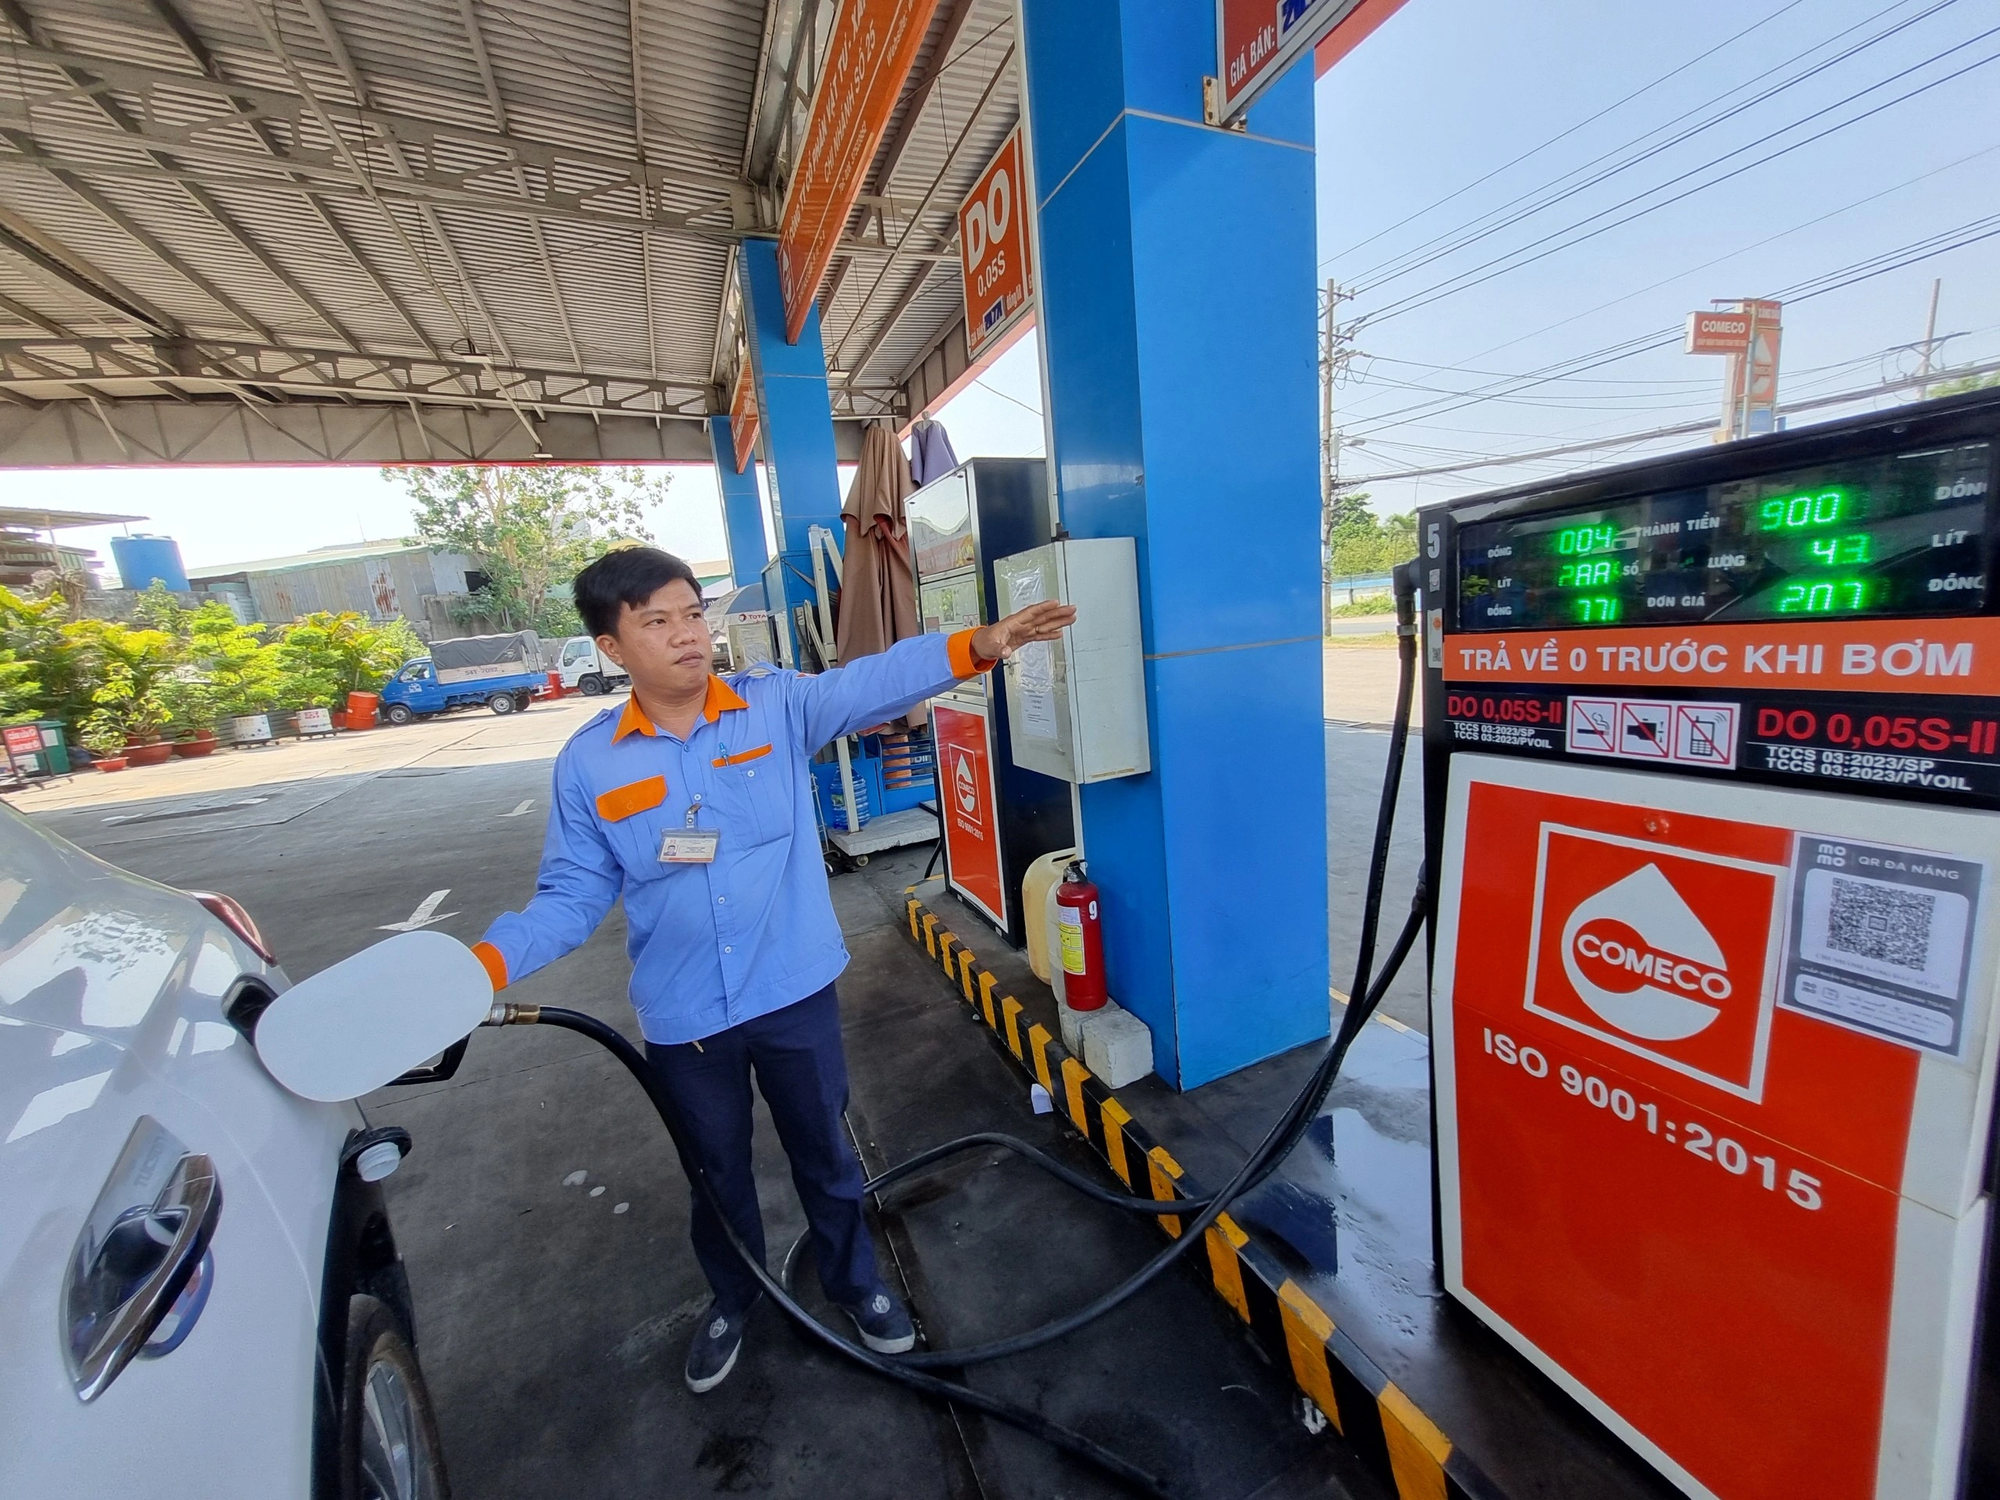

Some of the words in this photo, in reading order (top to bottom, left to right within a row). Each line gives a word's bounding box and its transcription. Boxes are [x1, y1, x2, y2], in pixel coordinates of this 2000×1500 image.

[1230, 45, 1247, 87] GIÁ
[1250, 24, 1275, 68] BÁN:
[966, 168, 1011, 275] DO
[977, 250, 1006, 298] 0,05S
[1701, 320, 1746, 334] COMECO
[1760, 492, 1840, 531] 900
[1427, 523, 1440, 559] 5
[1812, 534, 1870, 565] 43
[1932, 528, 1969, 548] LÍT
[1623, 560, 1640, 576] SỐ
[1681, 591, 1706, 607] GIÁ
[1460, 640, 1511, 671] TRẢ
[1520, 638, 1559, 671] VỀ
[1569, 647, 1587, 672] 0
[1596, 638, 1729, 673] TRƯỚC
[1744, 644, 1823, 674] KHI
[1842, 638, 1973, 676] BƠM
[1448, 696, 1478, 717] DO
[1482, 698, 1562, 724] 0,05S-II
[1454, 722, 1479, 733] TCCS
[1481, 724, 1535, 737] 03:2023/SP
[1454, 730, 1479, 741] TCCS
[1481, 733, 1553, 749] 03:2023/PVOIL
[1758, 709, 1816, 740] DO
[1826, 714, 1997, 754] 0,05S-II
[1765, 757, 1815, 774] TCCS
[1821, 762, 1972, 791] 03:2023/PVOIL
[1767, 746, 1816, 761] TCCS
[1822, 751, 1935, 772] 03:2023/SP
[1858, 856, 1880, 866] QR
[1911, 864, 1960, 880] NĂNG
[1089, 901, 1098, 920] 9
[1577, 933, 1732, 1001] COMECO
[1483, 1026, 1548, 1079] ISO
[1560, 1065, 1824, 1212] 9001:2015
